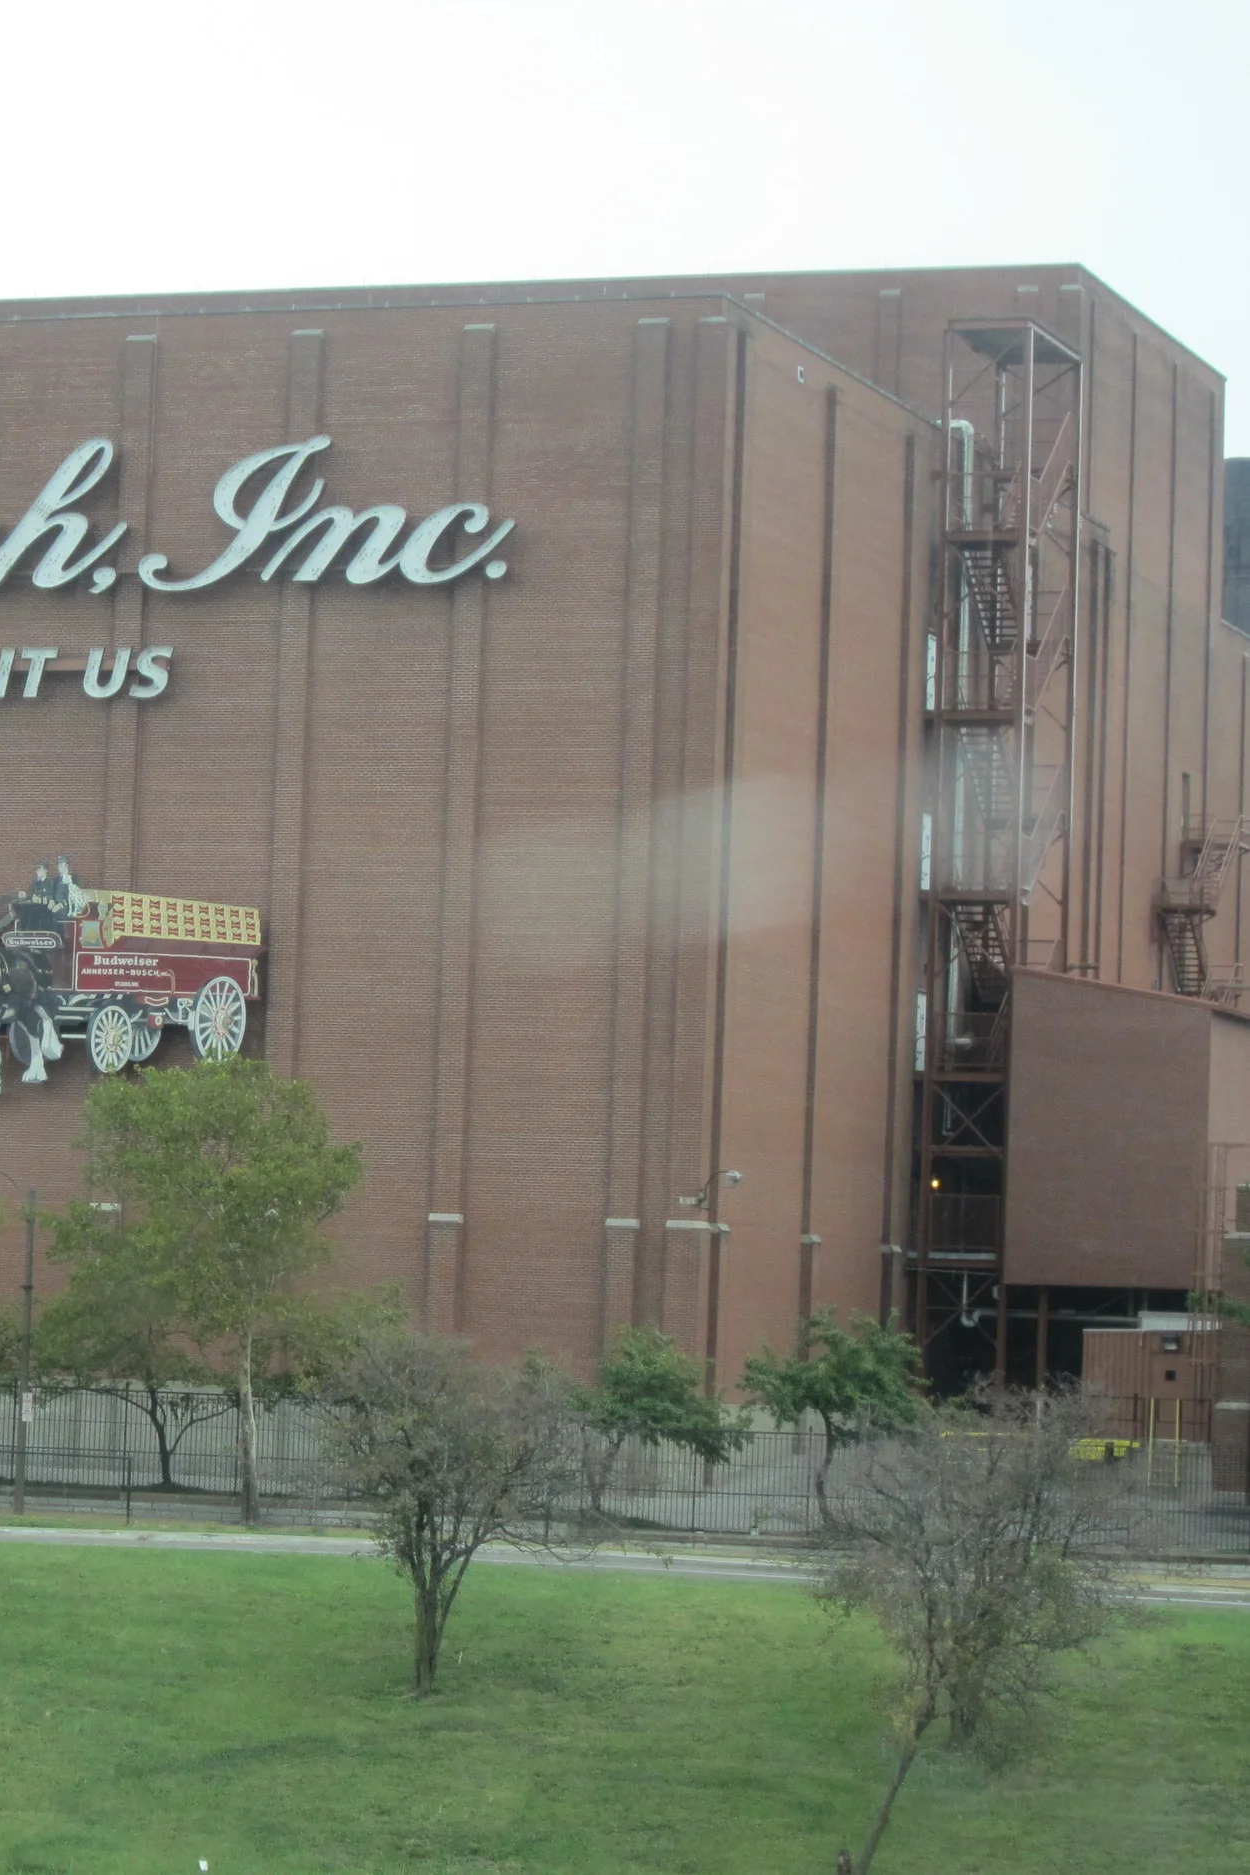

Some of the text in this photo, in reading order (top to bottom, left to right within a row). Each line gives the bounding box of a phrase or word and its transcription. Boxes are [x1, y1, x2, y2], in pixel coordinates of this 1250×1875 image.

[139, 435, 515, 591] Inc.
[82, 646, 174, 699] US
[93, 955, 159, 967] Budweiser
